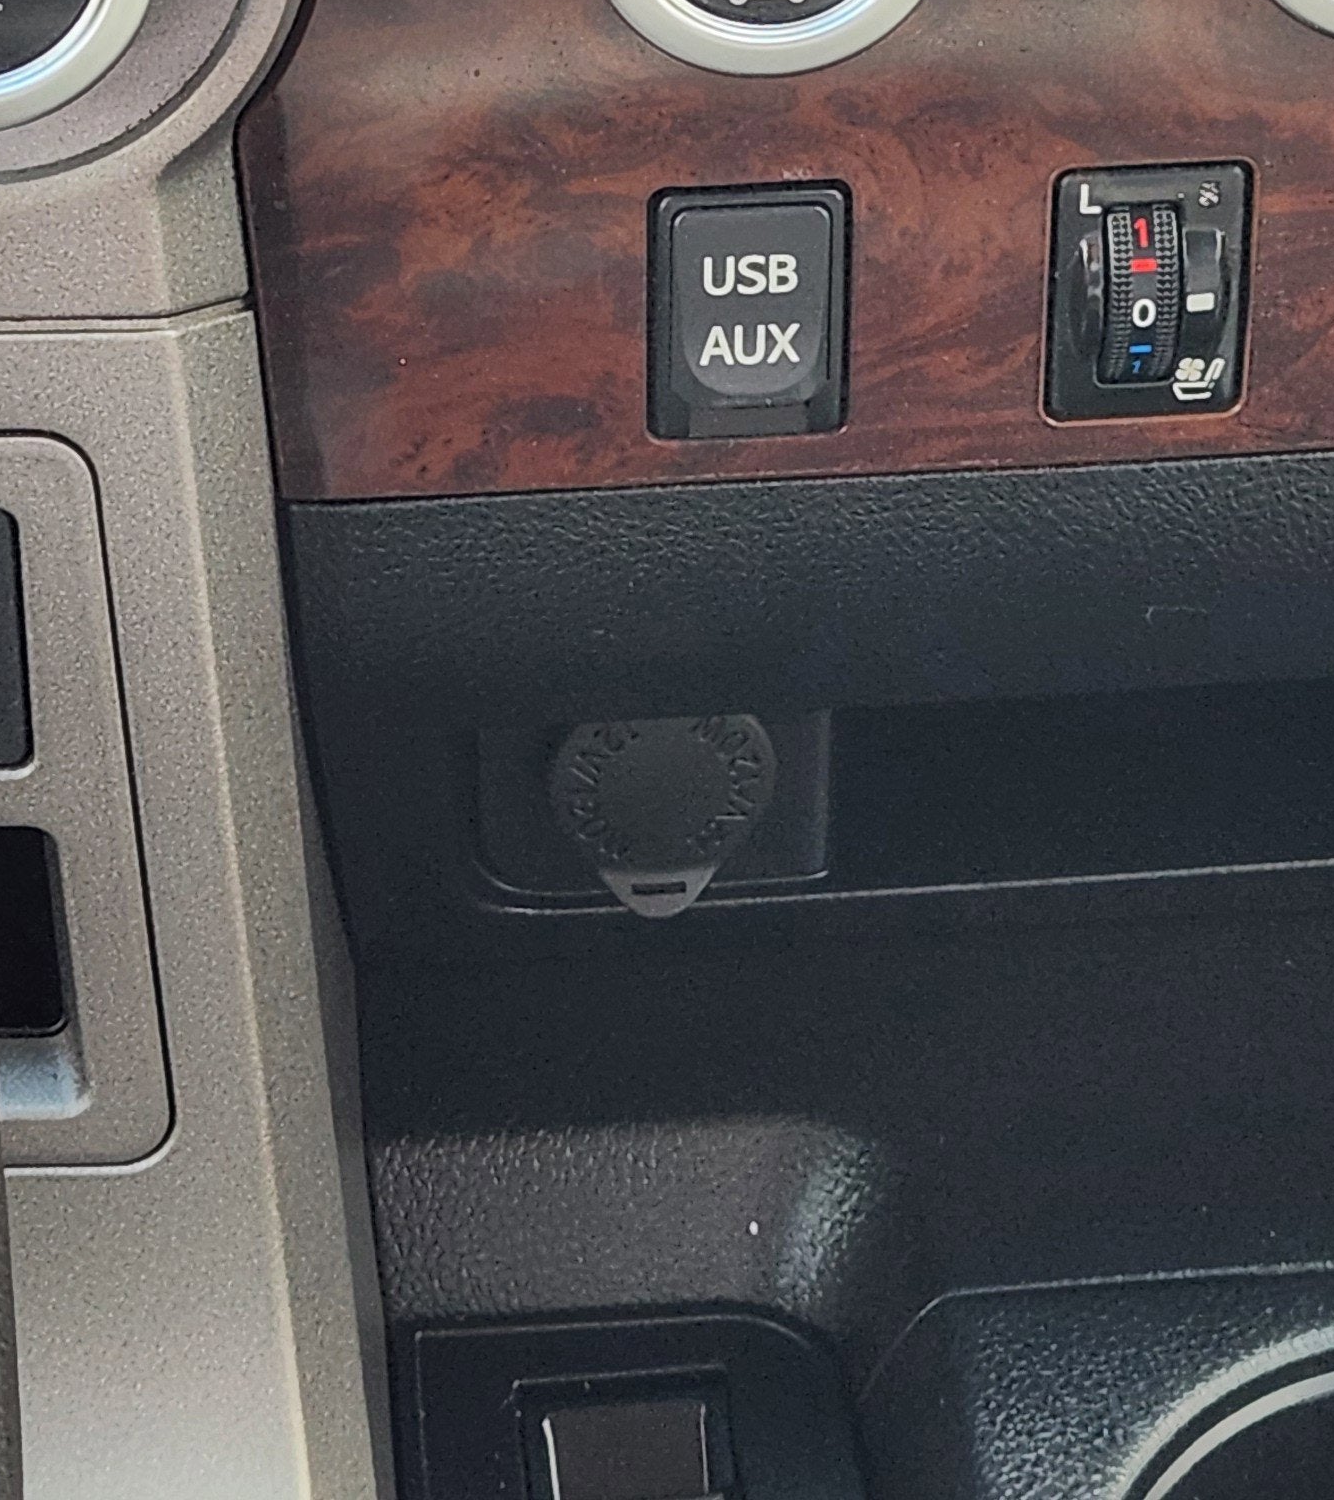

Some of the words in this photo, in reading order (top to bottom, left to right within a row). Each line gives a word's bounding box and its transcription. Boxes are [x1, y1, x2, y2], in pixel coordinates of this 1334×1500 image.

[1079, 183, 1103, 215] L
[1133, 216, 1150, 248] 1
[702, 253, 799, 297] USB
[1131, 297, 1157, 329] 0
[698, 322, 801, 367] AUX
